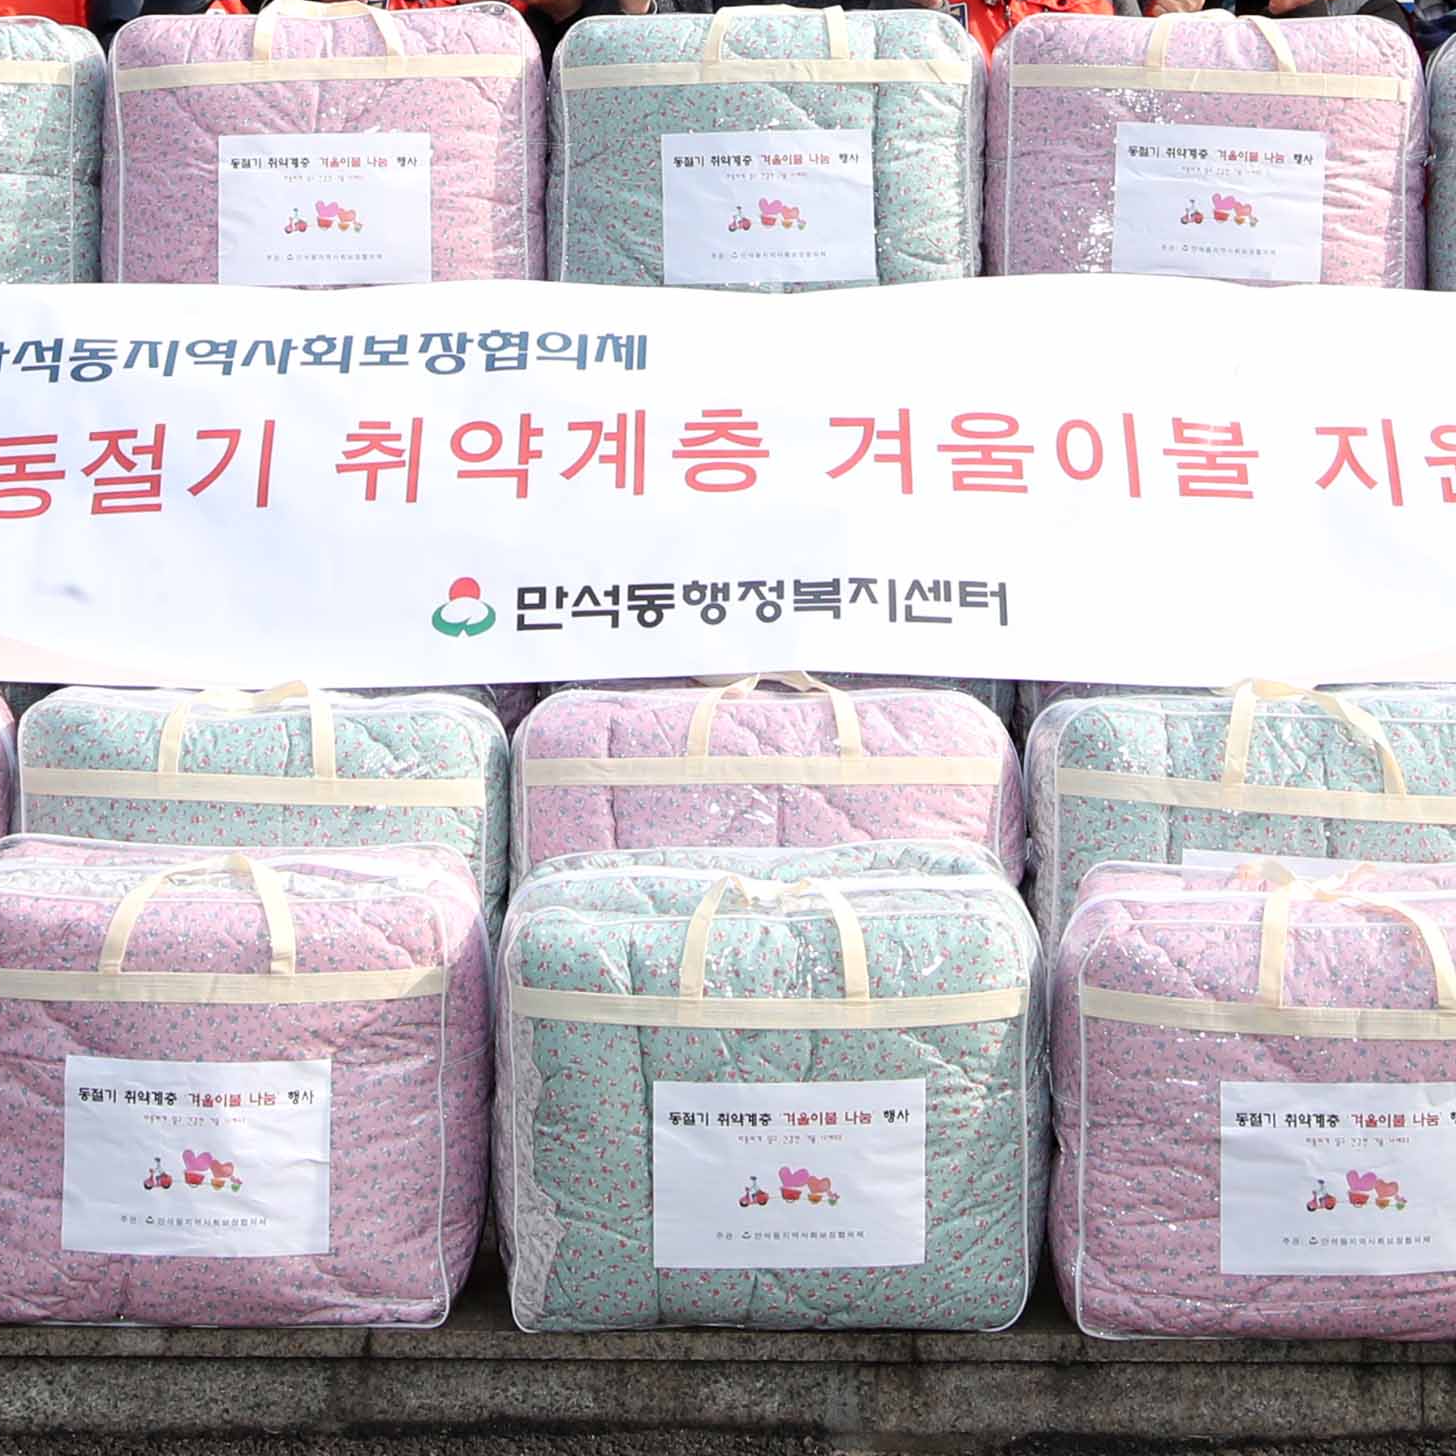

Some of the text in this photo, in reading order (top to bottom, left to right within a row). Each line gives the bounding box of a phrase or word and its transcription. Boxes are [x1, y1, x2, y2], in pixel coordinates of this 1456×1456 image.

[335, 408, 770, 504] 취약계층
[826, 407, 1260, 500] 겨울이불
[516, 577, 1008, 630] 만석동행정복지센터
[78, 1088, 117, 1102] 동절기
[124, 1090, 177, 1106] 취약계층
[288, 1090, 314, 1105] 행사
[668, 1112, 709, 1126] 동절기
[717, 1112, 772, 1126] 취약계층
[884, 1109, 910, 1124] 행사
[1236, 1112, 1276, 1127] 동절기
[1284, 1112, 1340, 1128] 취약계층
